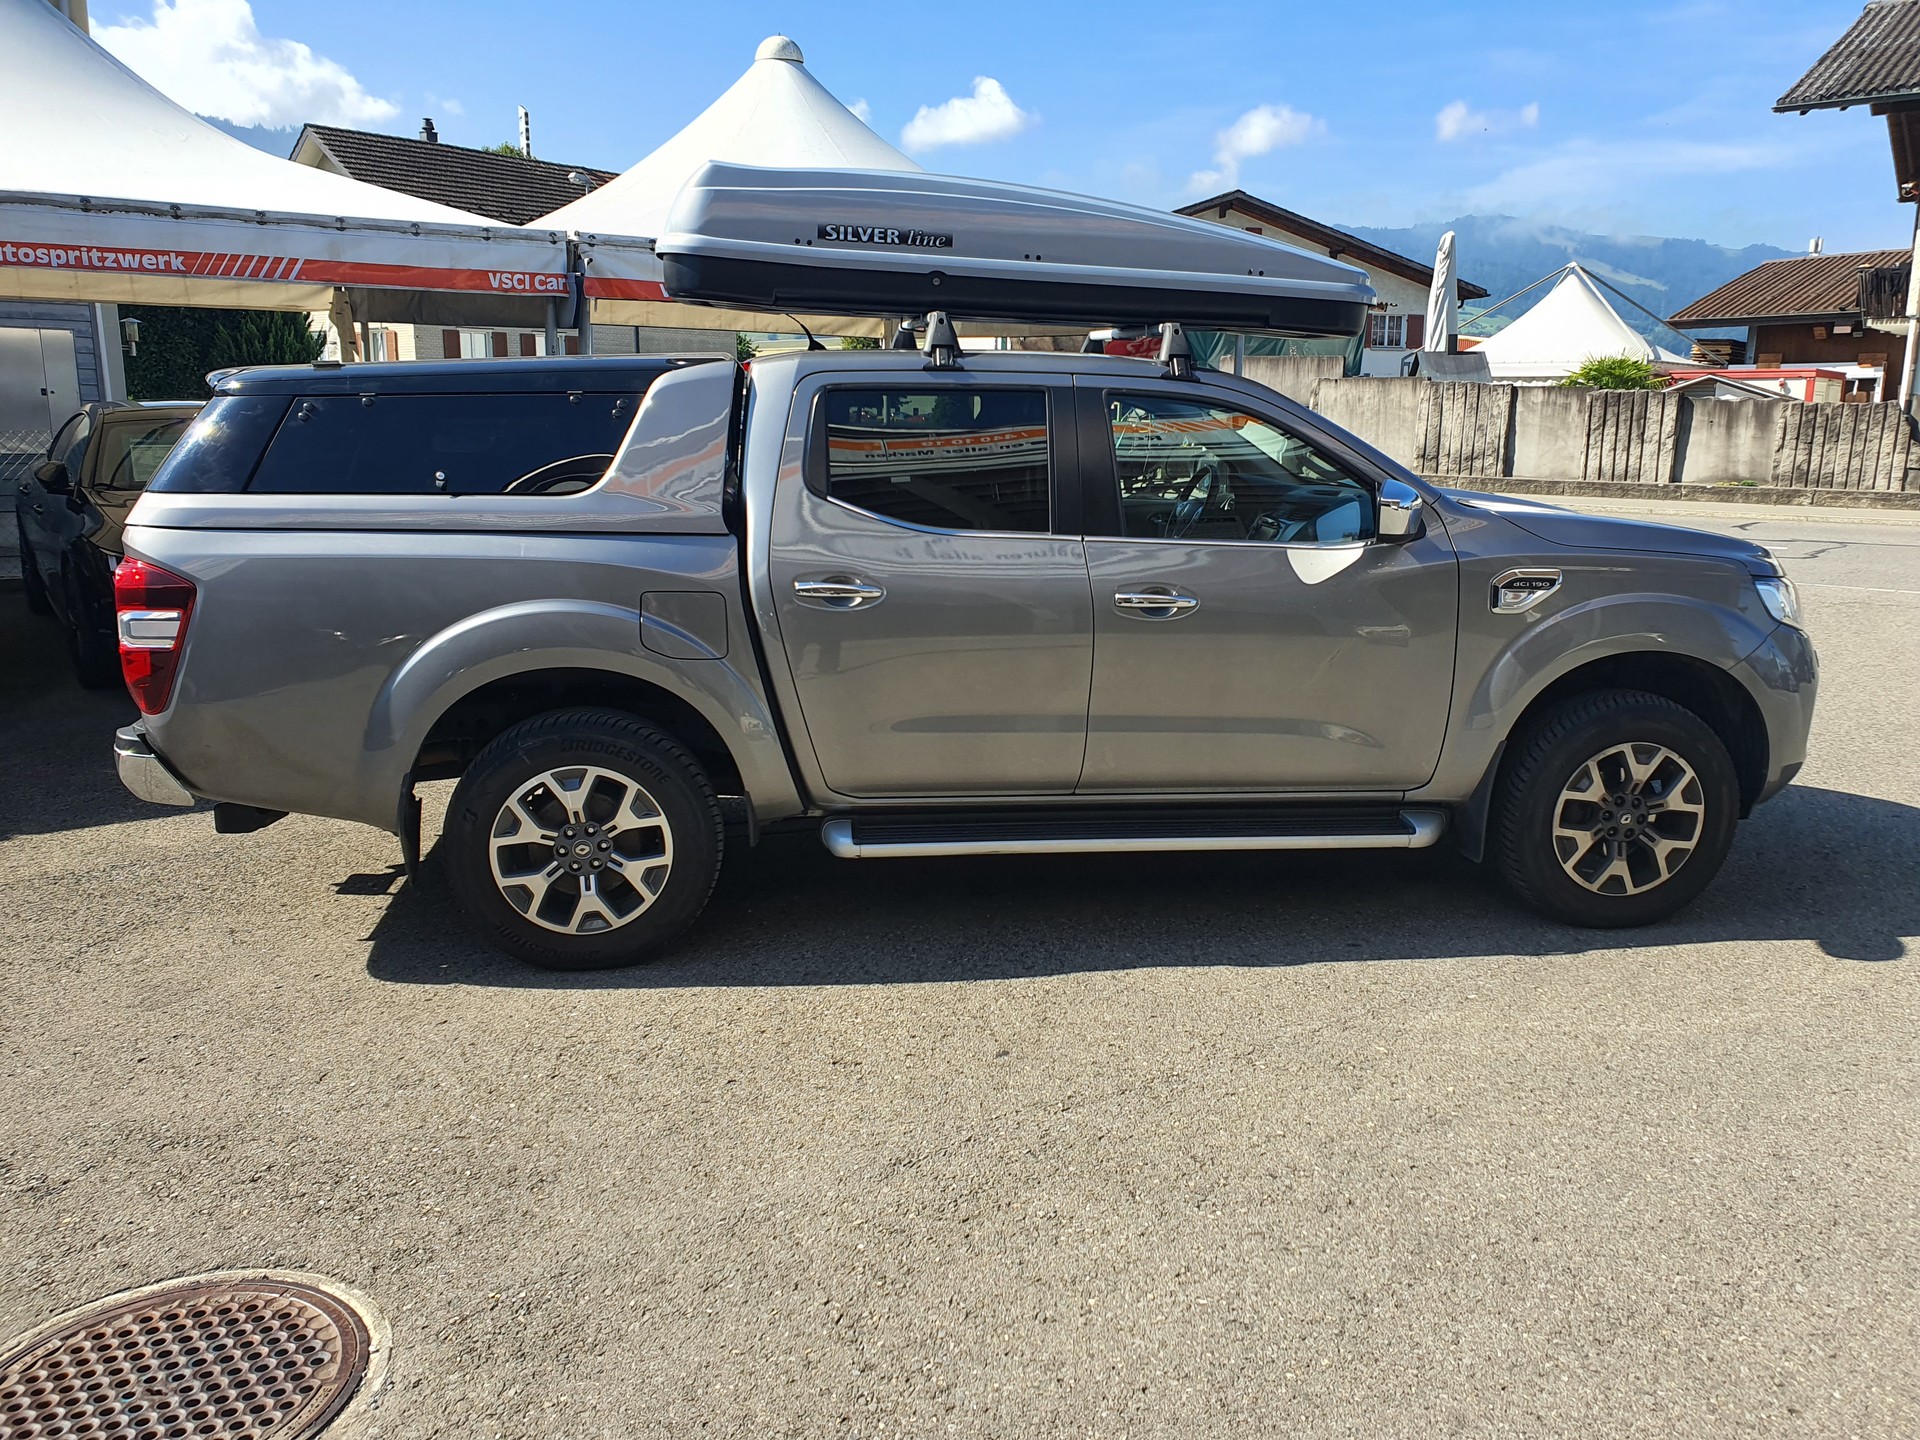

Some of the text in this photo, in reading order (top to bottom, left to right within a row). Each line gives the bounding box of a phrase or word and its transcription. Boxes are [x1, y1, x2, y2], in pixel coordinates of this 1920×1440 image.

[825, 224, 946, 247] SILVER line
[0, 243, 186, 271] tospritzwerk
[488, 272, 569, 290] VSCI Car
